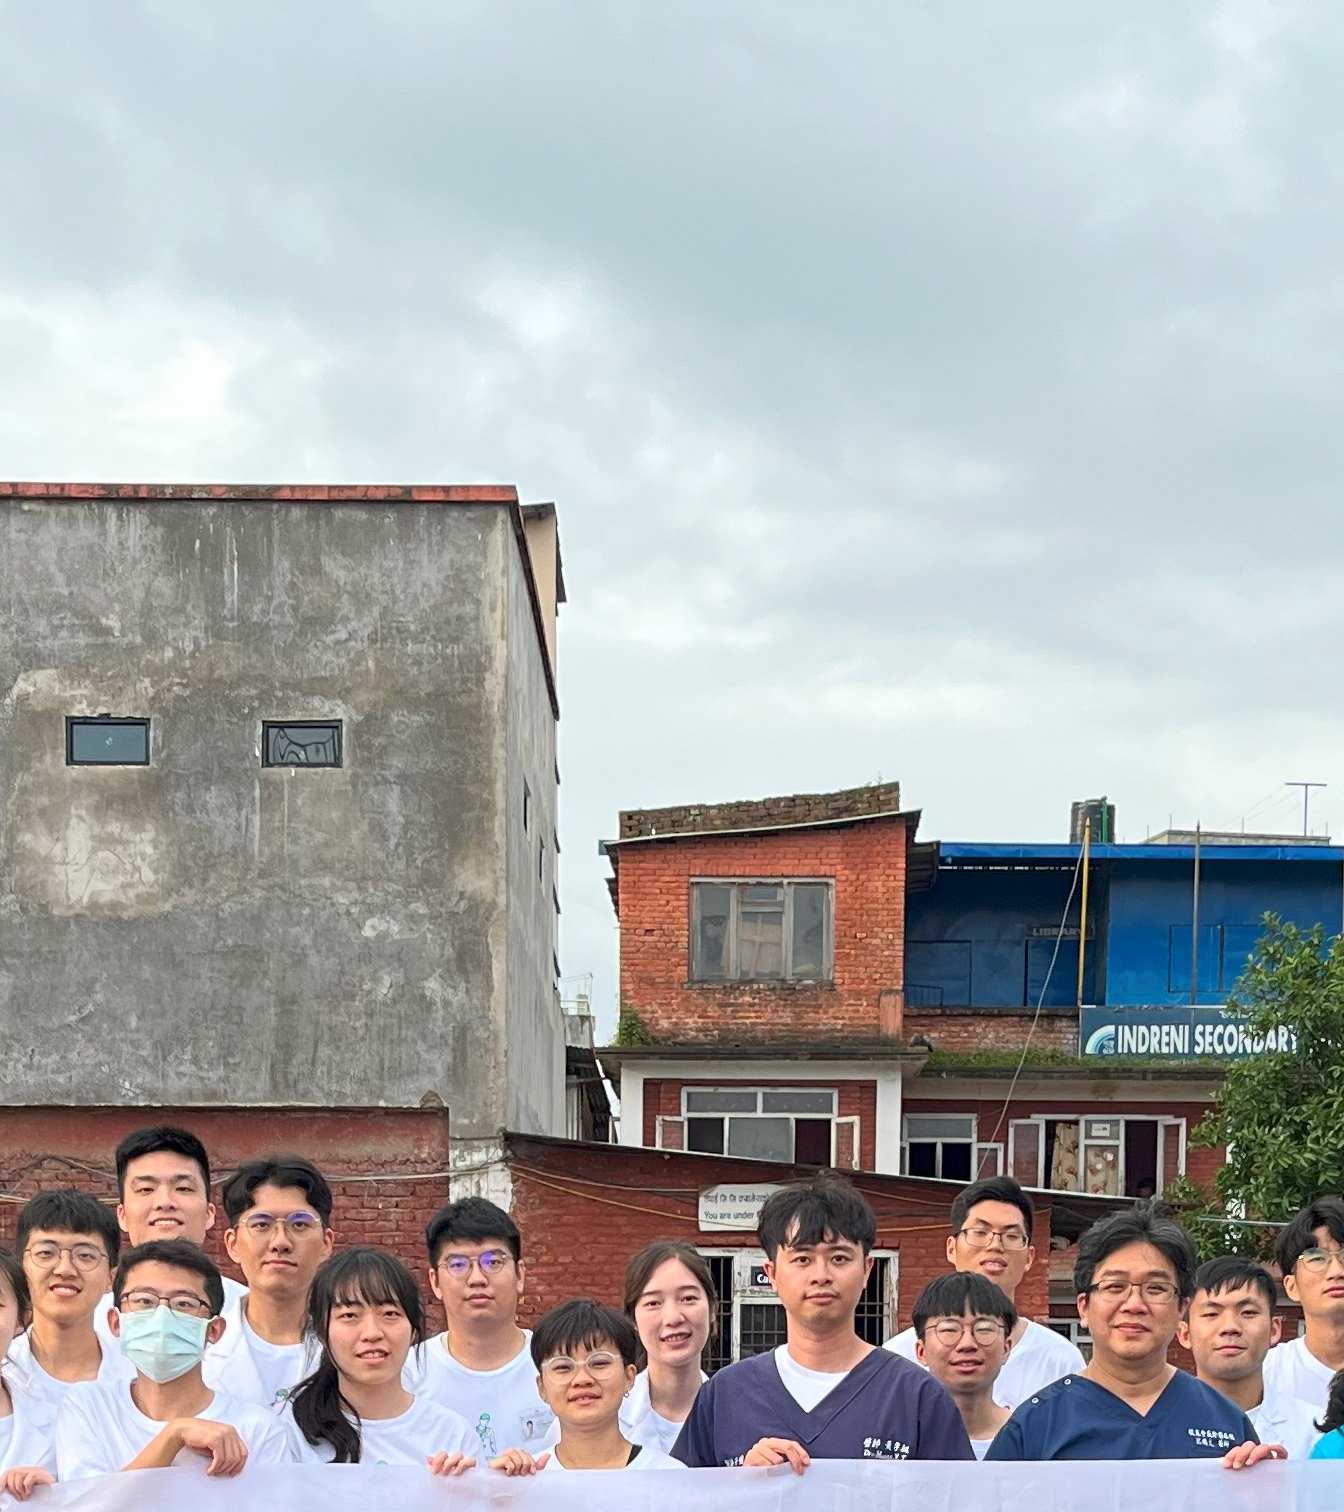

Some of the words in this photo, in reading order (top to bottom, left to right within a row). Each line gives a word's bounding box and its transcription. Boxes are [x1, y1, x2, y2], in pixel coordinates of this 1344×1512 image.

[1118, 1024, 1189, 1054] INDRENI
[704, 1211, 718, 1220] You
[720, 1212, 732, 1220] are
[733, 1210, 755, 1220] under
